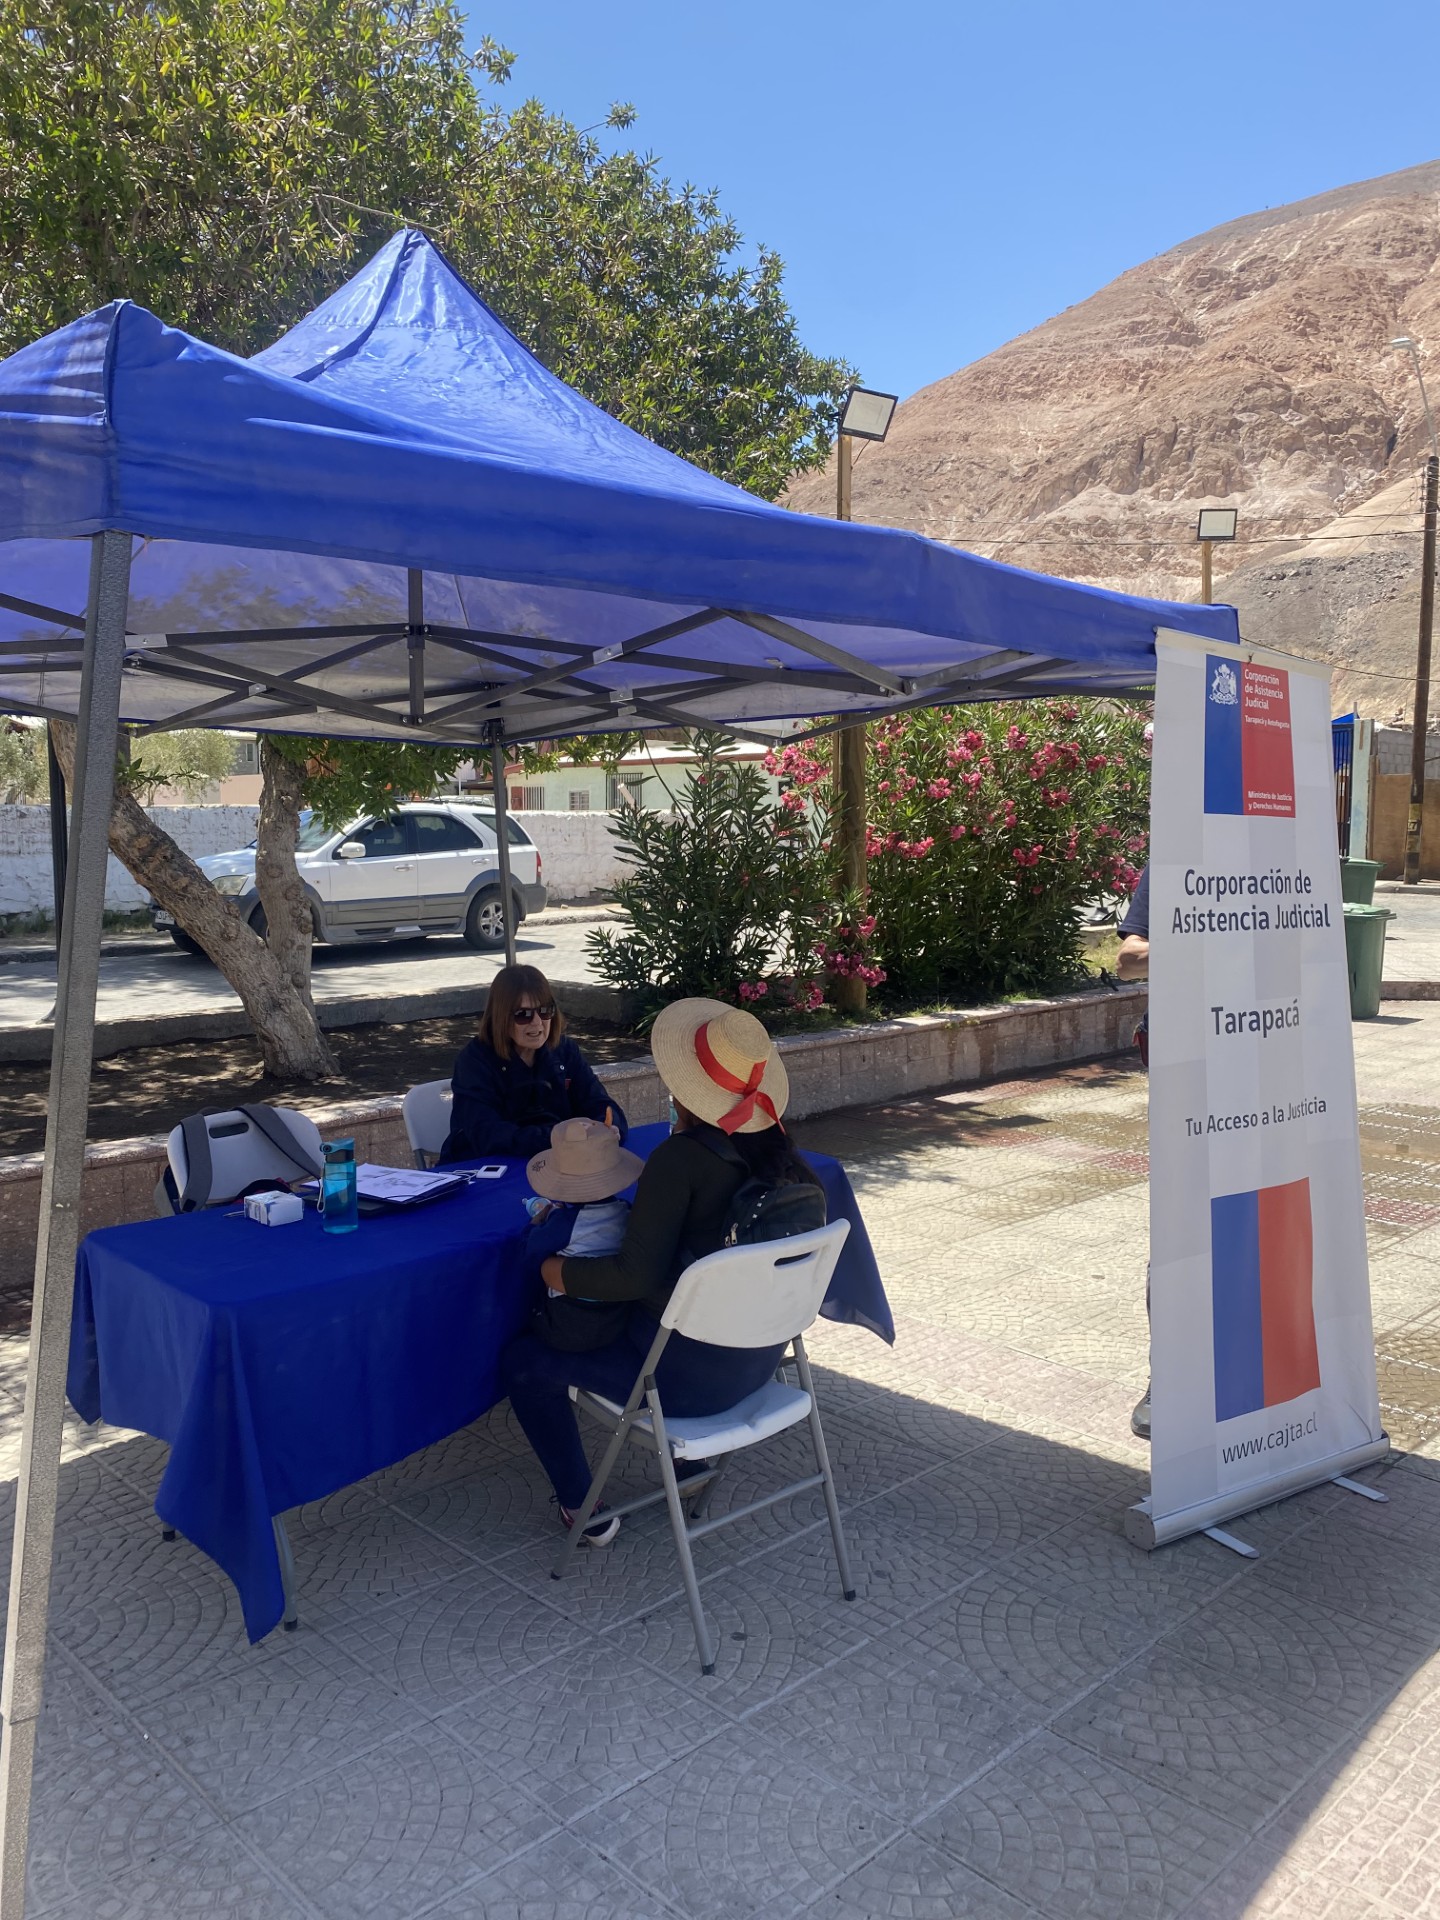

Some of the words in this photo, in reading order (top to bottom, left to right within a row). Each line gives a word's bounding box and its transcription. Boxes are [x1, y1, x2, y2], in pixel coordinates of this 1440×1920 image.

[1245, 669, 1279, 685] Corporación
[1245, 683, 1253, 693] de
[1254, 684, 1283, 699] Asistencia
[1245, 697, 1269, 709] Judicial
[1184, 868, 1292, 902] Corporación
[1294, 869, 1312, 894] de
[1171, 905, 1270, 934] Asistencia
[1274, 903, 1331, 930] Judicial
[1211, 998, 1300, 1038] Tarapacá
[1185, 1118, 1202, 1137] Tu
[1206, 1113, 1259, 1134] Acceso
[1261, 1111, 1270, 1126] a
[1272, 1105, 1285, 1123] la
[1287, 1096, 1327, 1121] Justicia
[1222, 1411, 1318, 1464] www.cajta.cl
